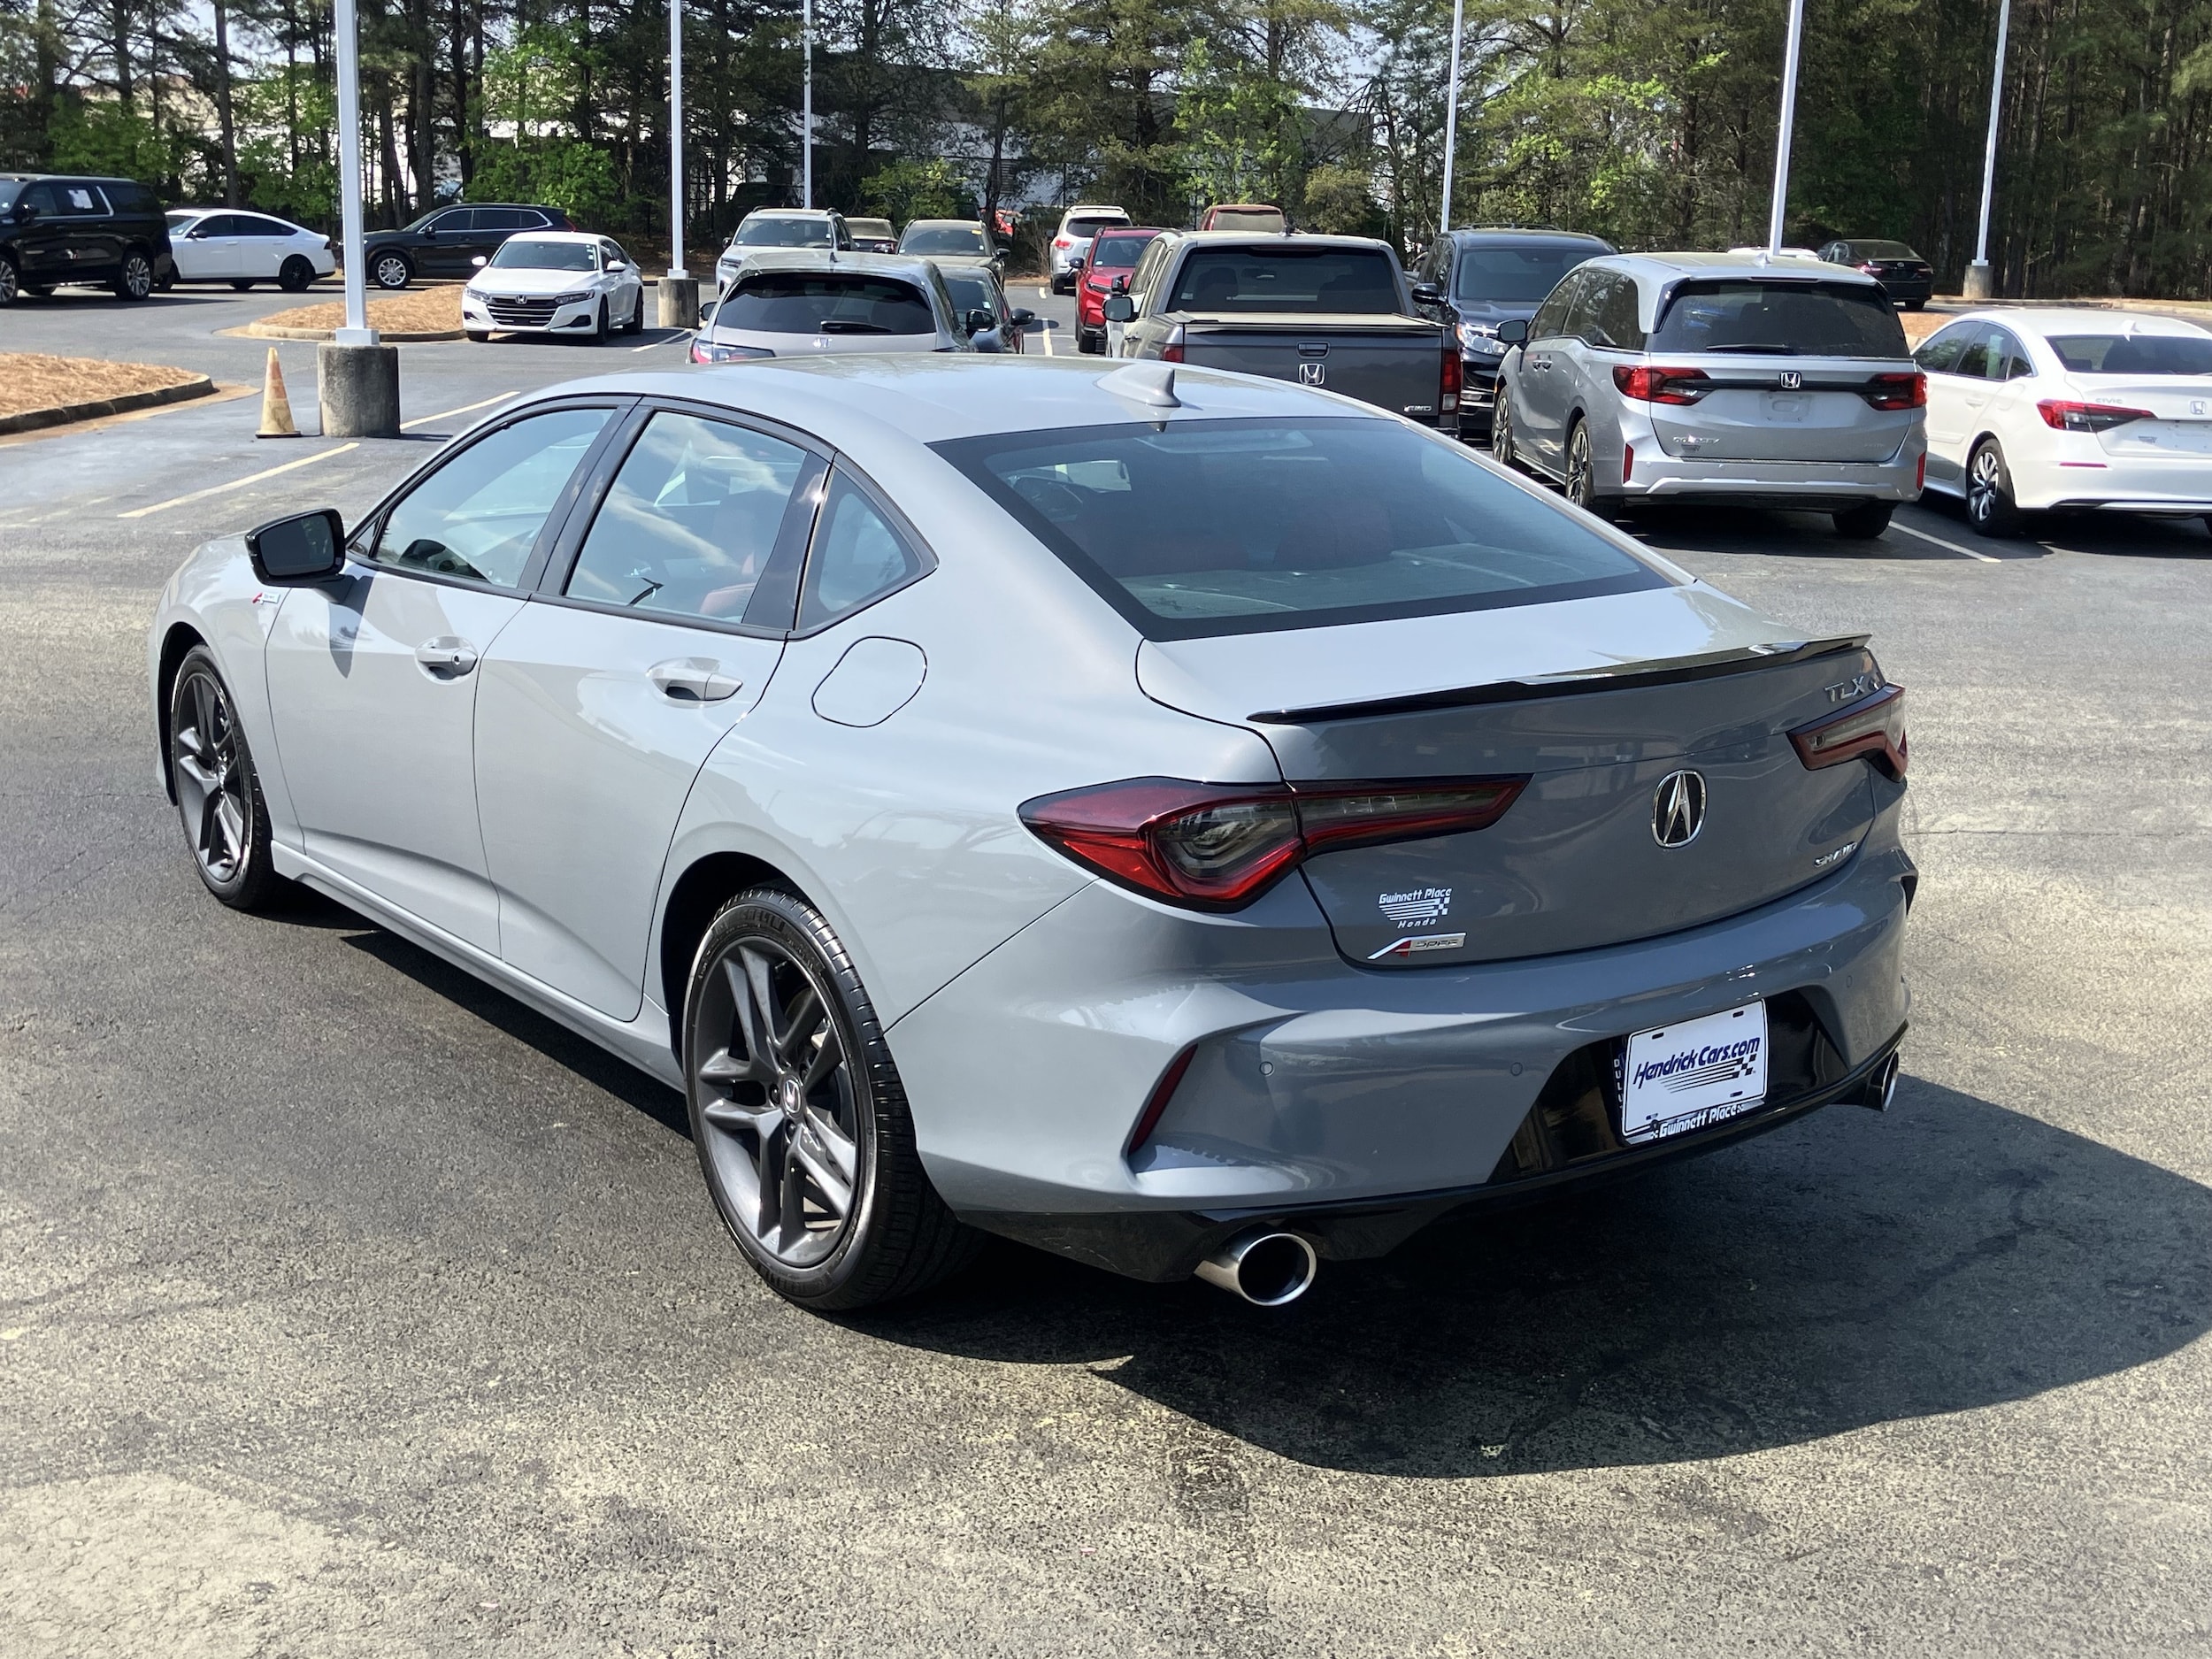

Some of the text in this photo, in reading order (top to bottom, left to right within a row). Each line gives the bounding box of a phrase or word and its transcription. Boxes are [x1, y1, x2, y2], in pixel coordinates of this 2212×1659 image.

[1824, 676, 1864, 702] TLX
[1379, 887, 1452, 904] Gwinnett Place
[1397, 918, 1436, 928] Honda
[1613, 1058, 1624, 1109] DULU
[1659, 1104, 1738, 1138] Gwinnett Place
